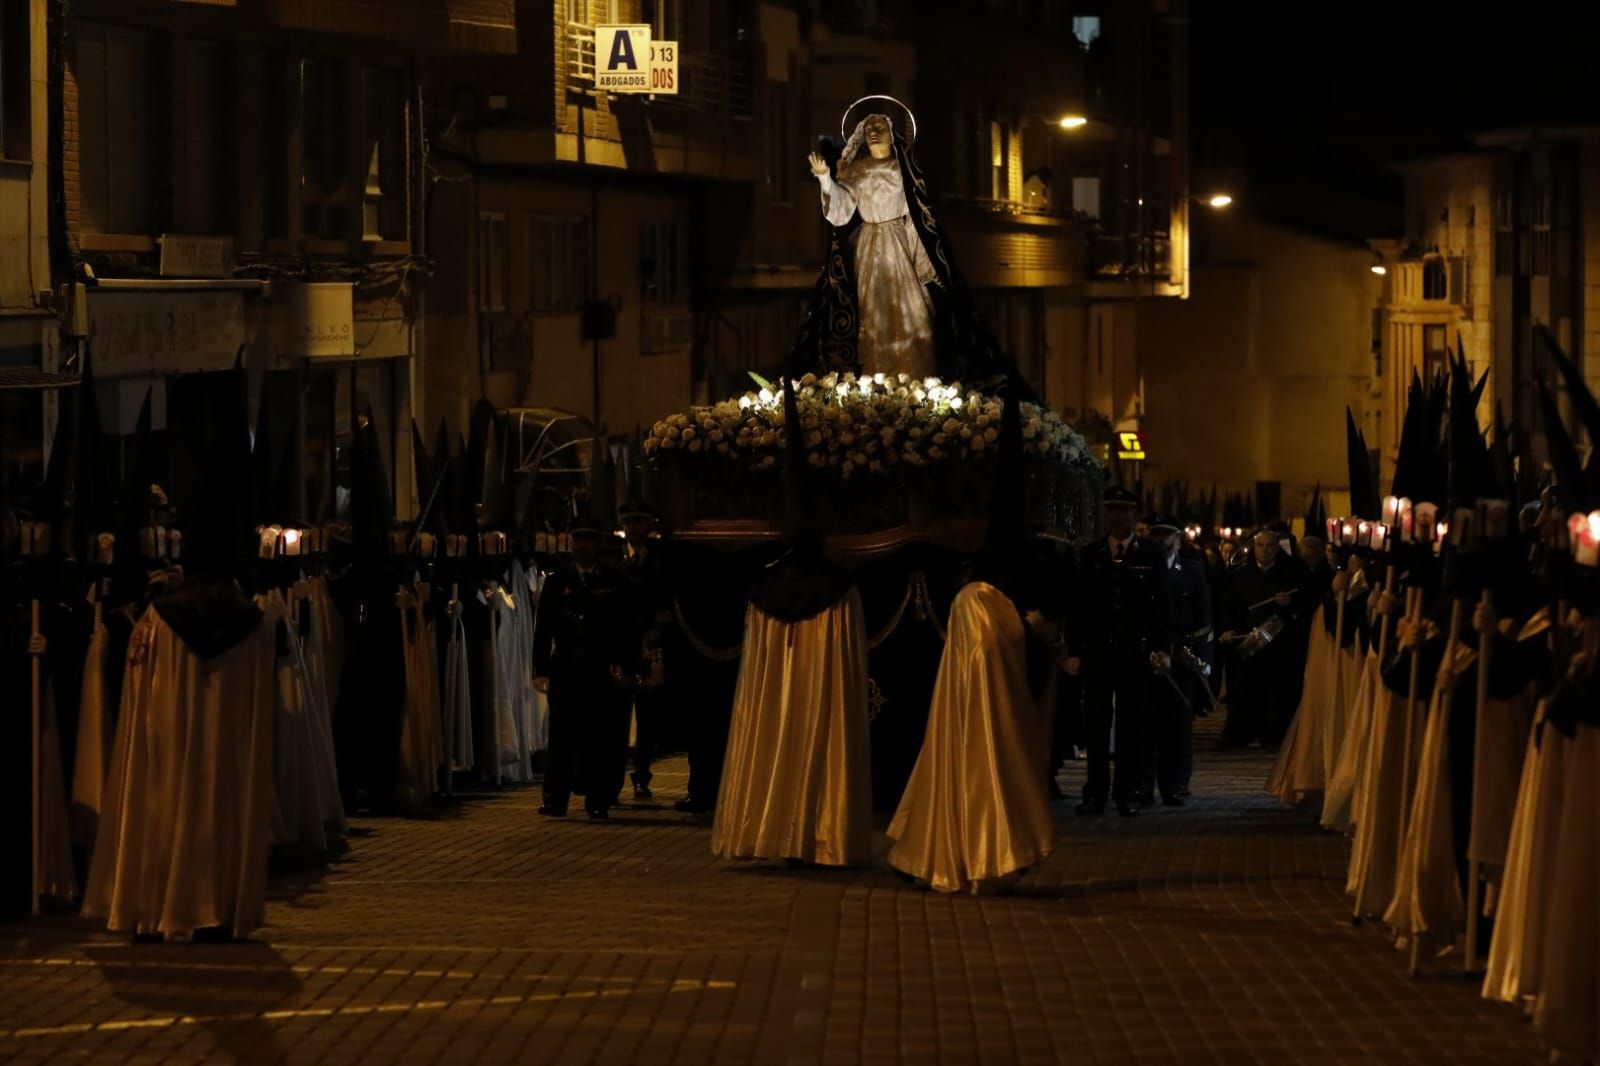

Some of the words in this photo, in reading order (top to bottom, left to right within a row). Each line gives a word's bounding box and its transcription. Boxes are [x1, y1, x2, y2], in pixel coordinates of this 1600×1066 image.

[607, 30, 638, 70] A
[659, 47, 673, 62] 13
[600, 76, 646, 86] ABOGADOS
